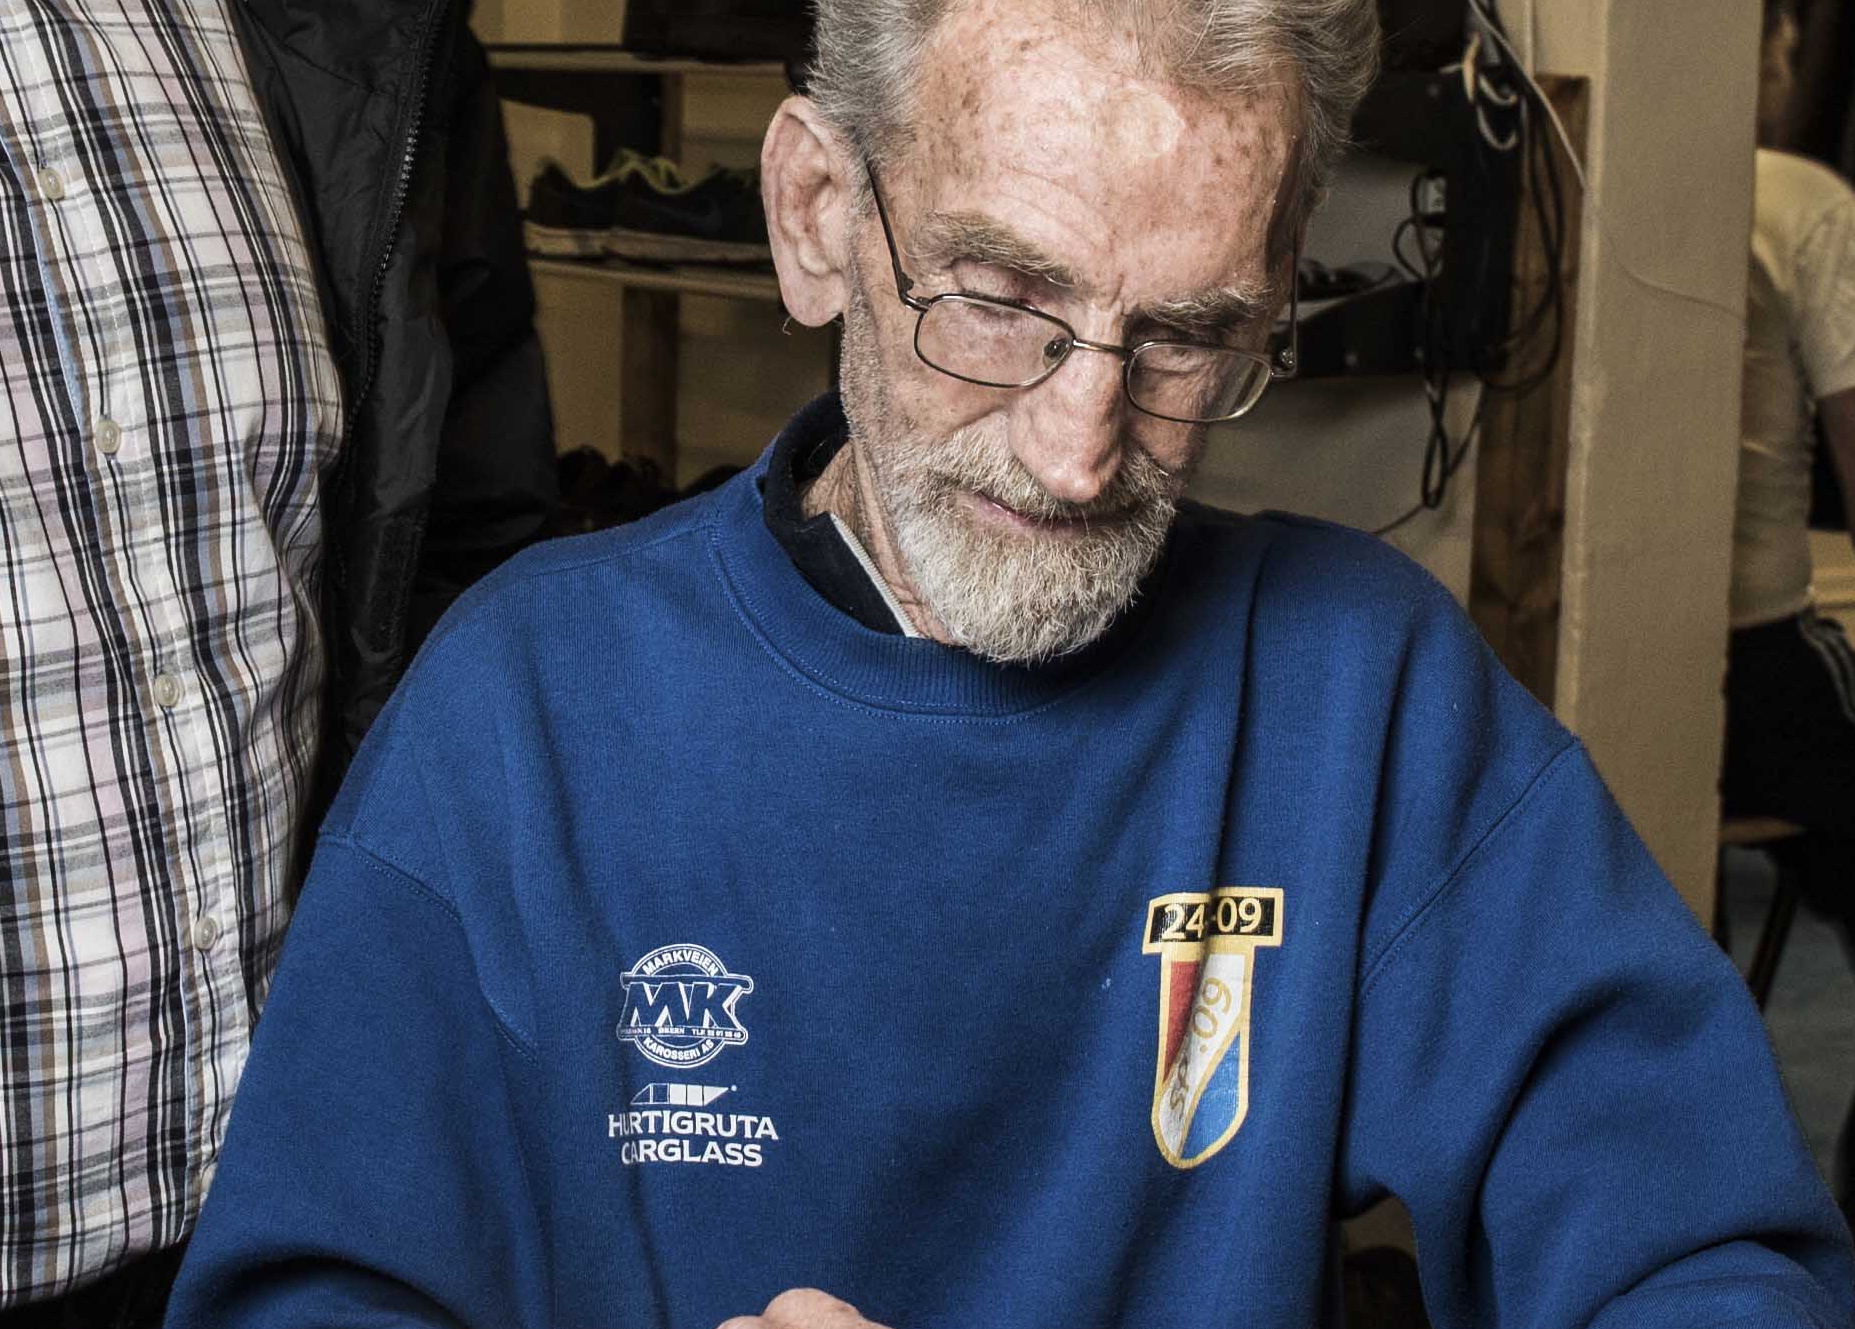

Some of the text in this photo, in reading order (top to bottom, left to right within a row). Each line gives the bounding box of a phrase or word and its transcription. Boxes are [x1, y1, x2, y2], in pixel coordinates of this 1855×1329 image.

[642, 949, 719, 975] MARKVEIEN
[620, 981, 746, 1028] MK
[643, 1037, 714, 1061] KAROSSERI AS
[608, 1110, 779, 1140] HURTIGRUTA
[621, 1139, 763, 1167] CARGLASS
